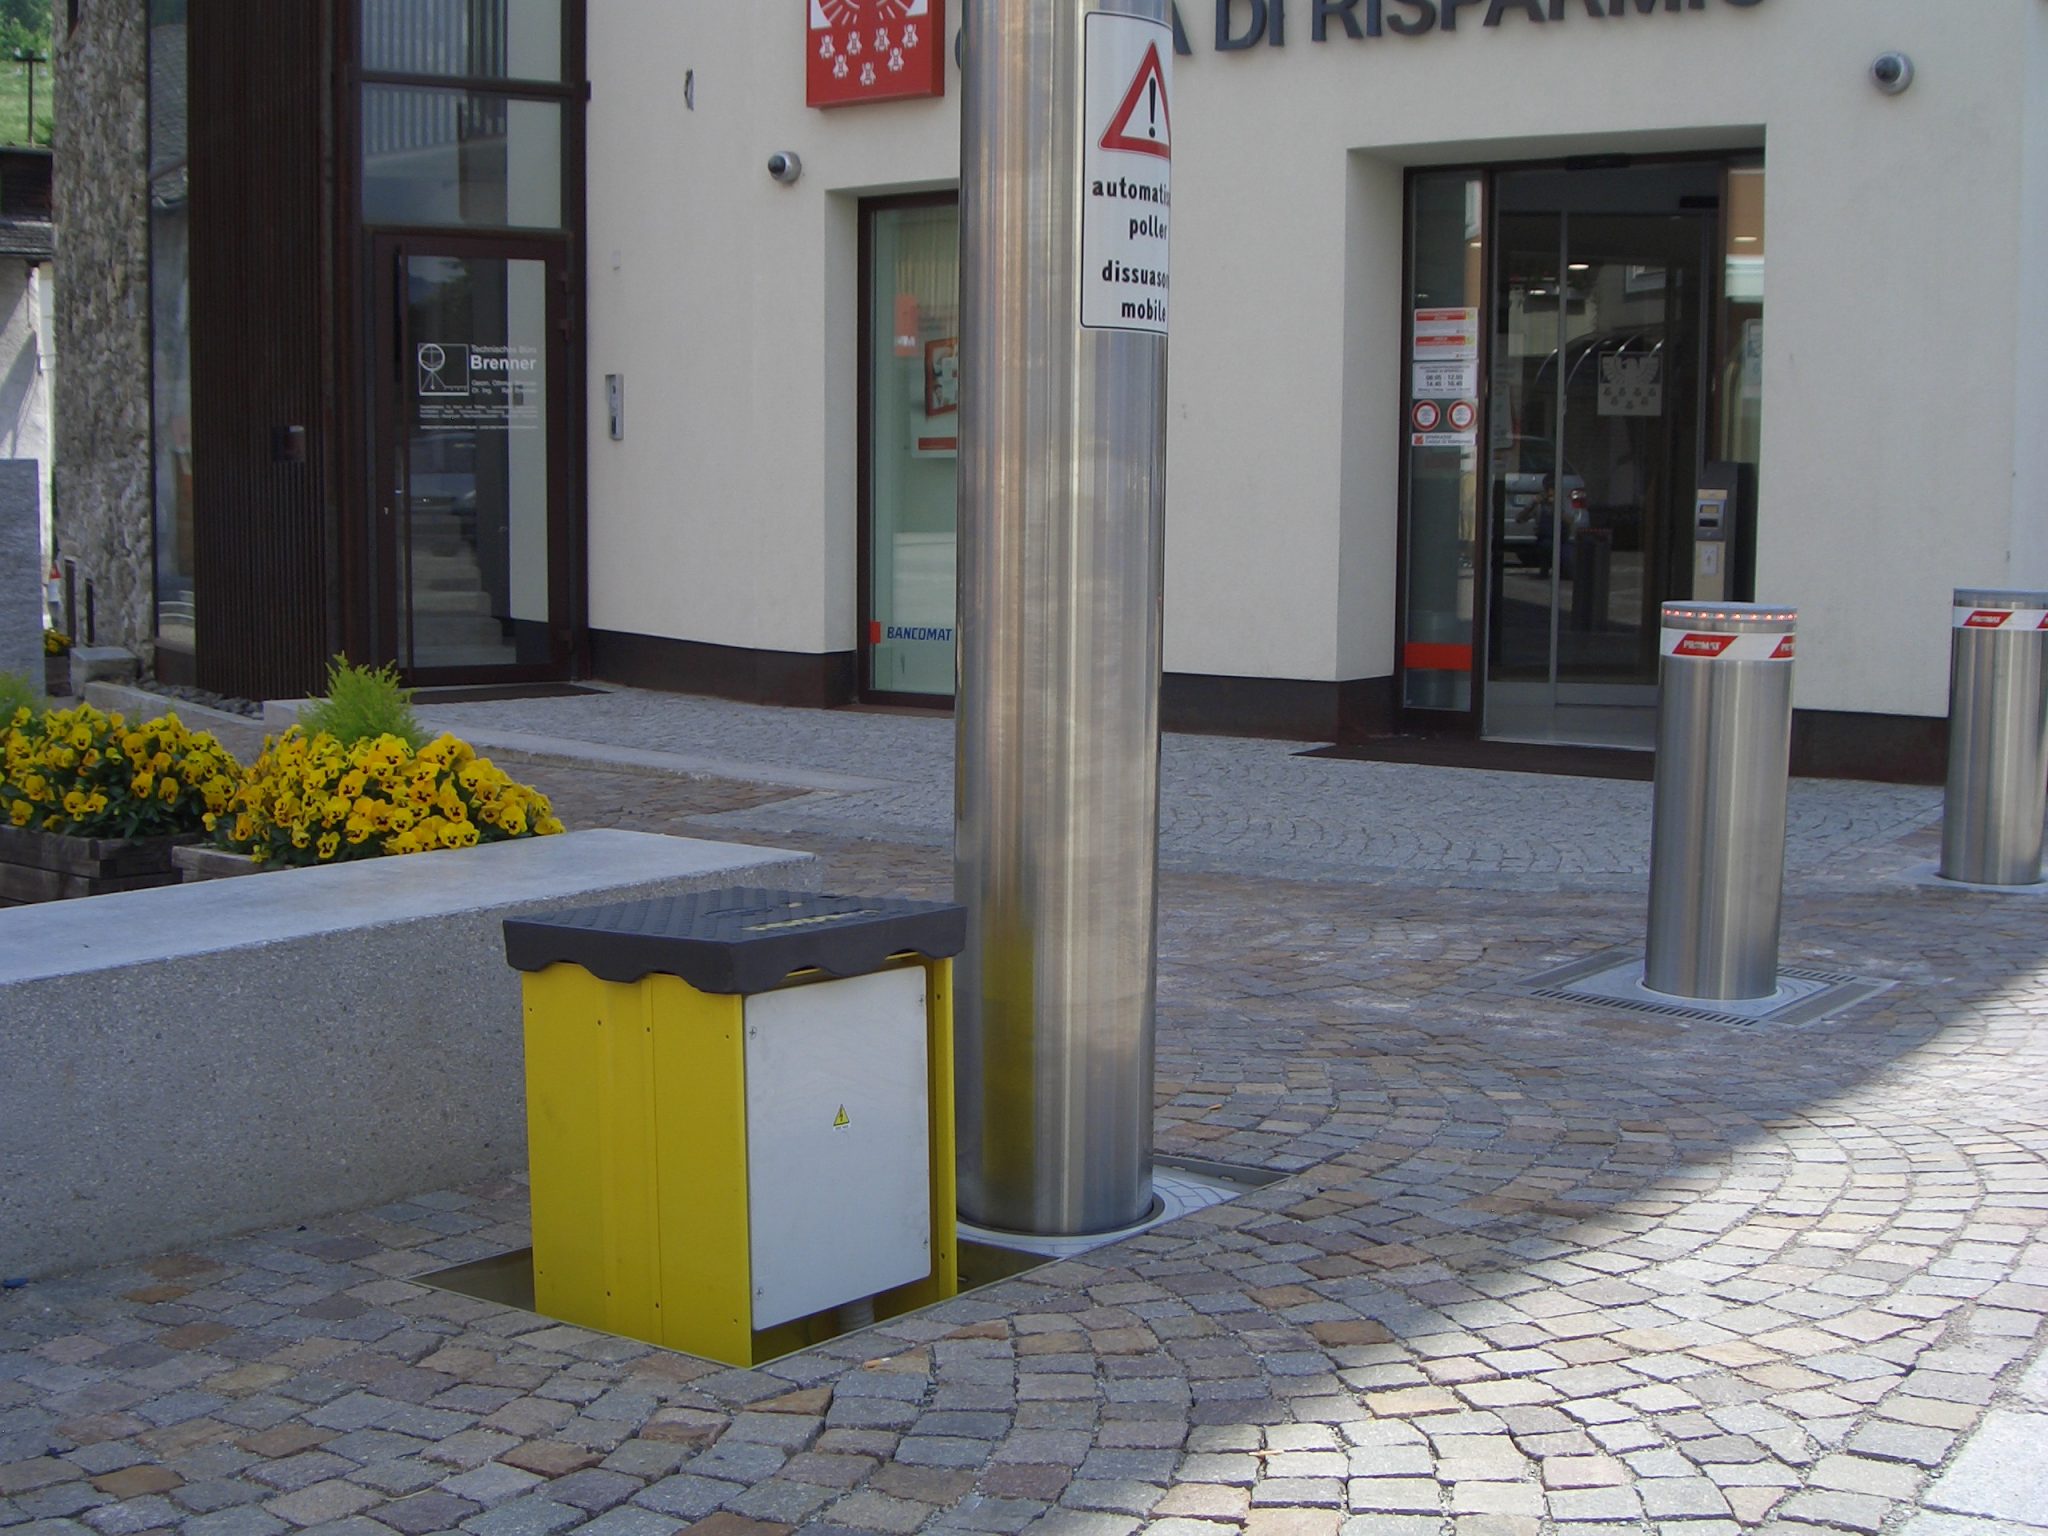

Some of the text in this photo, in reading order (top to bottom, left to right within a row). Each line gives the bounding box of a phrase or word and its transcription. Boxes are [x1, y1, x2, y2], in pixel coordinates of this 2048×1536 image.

[1129, 214, 1168, 240] poller
[1121, 298, 1166, 322] mobile
[470, 355, 536, 370] Brenner
[887, 626, 952, 641] BANCOMAT
